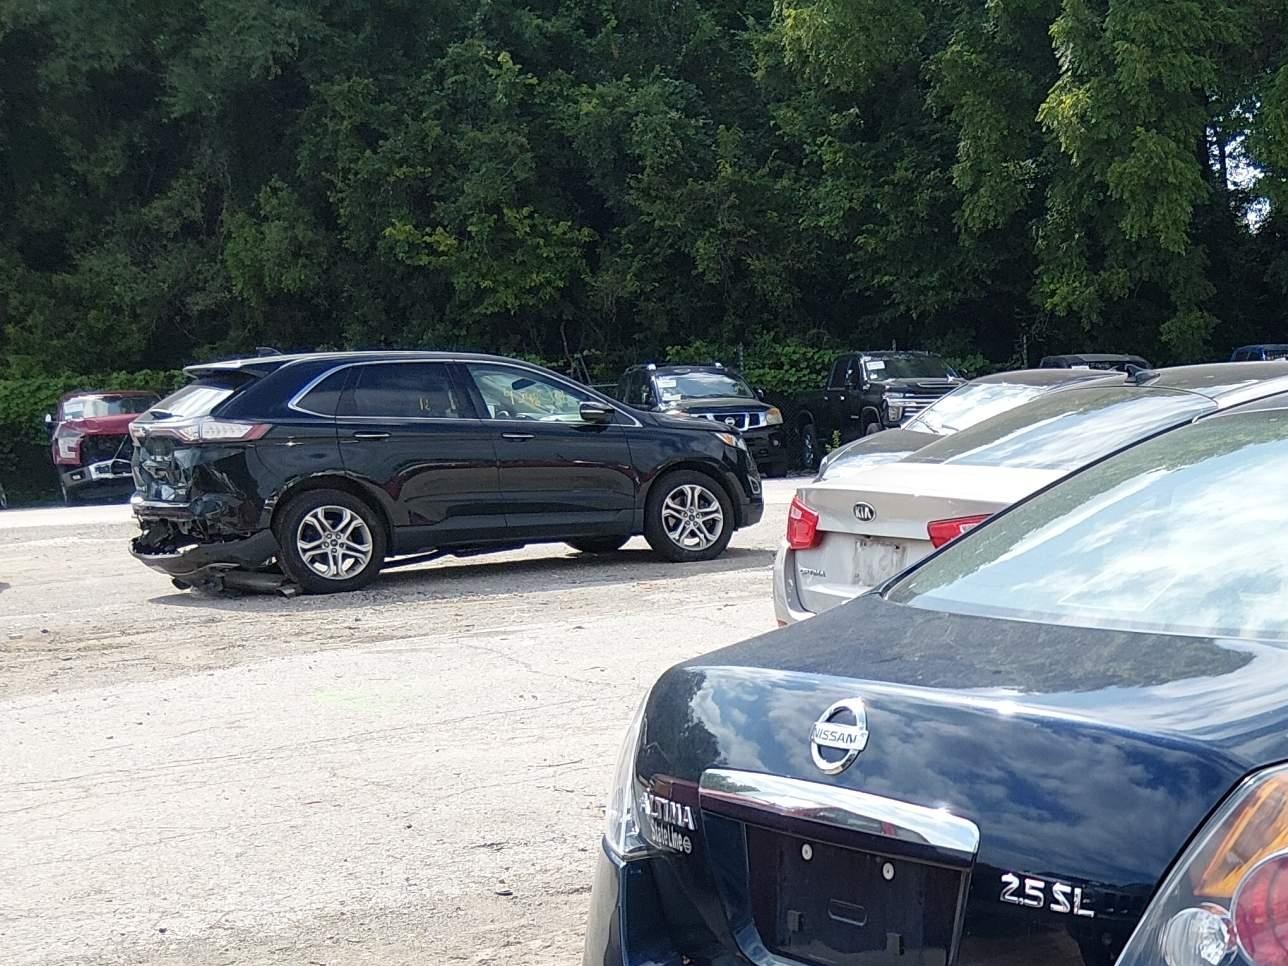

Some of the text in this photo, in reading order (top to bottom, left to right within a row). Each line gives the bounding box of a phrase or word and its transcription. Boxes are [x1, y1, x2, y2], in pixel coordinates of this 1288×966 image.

[855, 506, 872, 520] KIA
[814, 727, 857, 745] NISSAN
[1000, 873, 1095, 918] 2.5 SL
